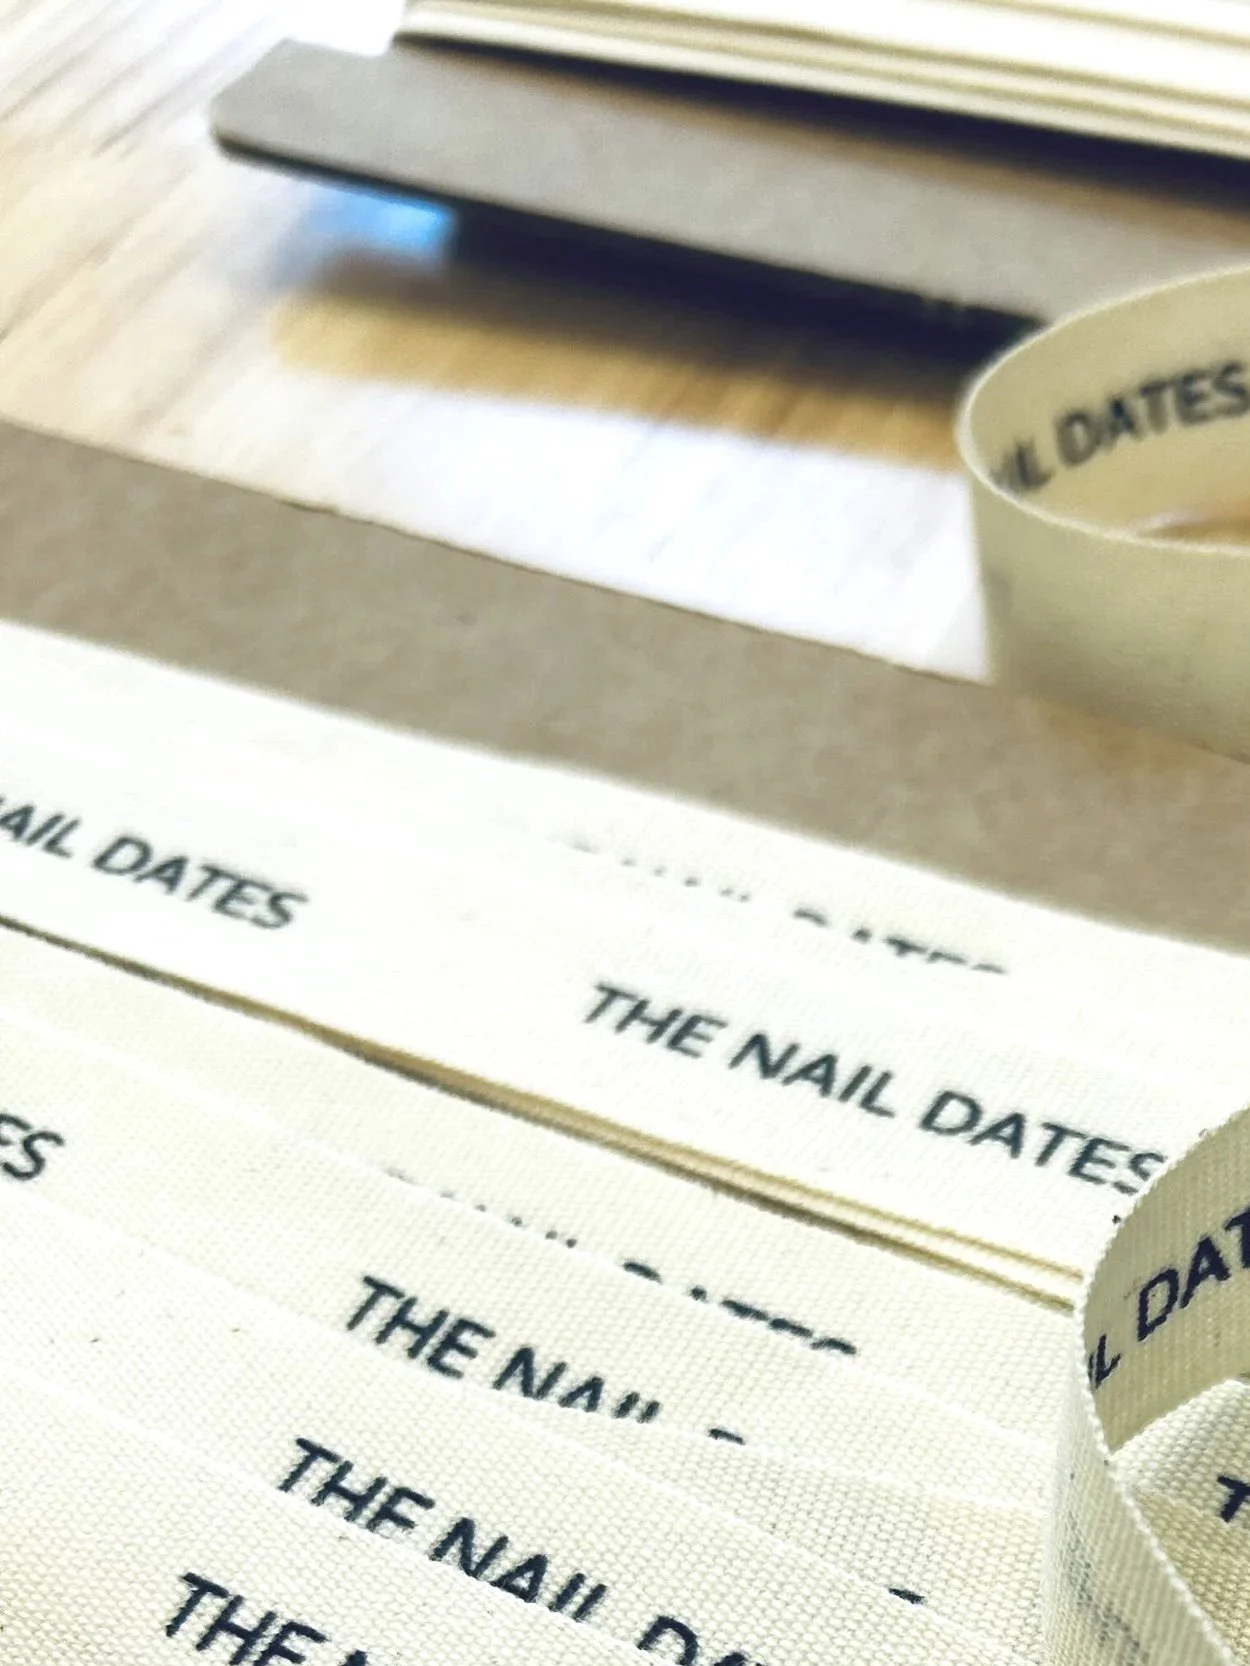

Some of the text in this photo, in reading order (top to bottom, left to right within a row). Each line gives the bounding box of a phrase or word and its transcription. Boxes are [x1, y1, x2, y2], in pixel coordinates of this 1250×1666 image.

[92, 835, 307, 929] DATES
[585, 983, 1168, 1196] THE NAIL DATES
[346, 1275, 496, 1378] THE
